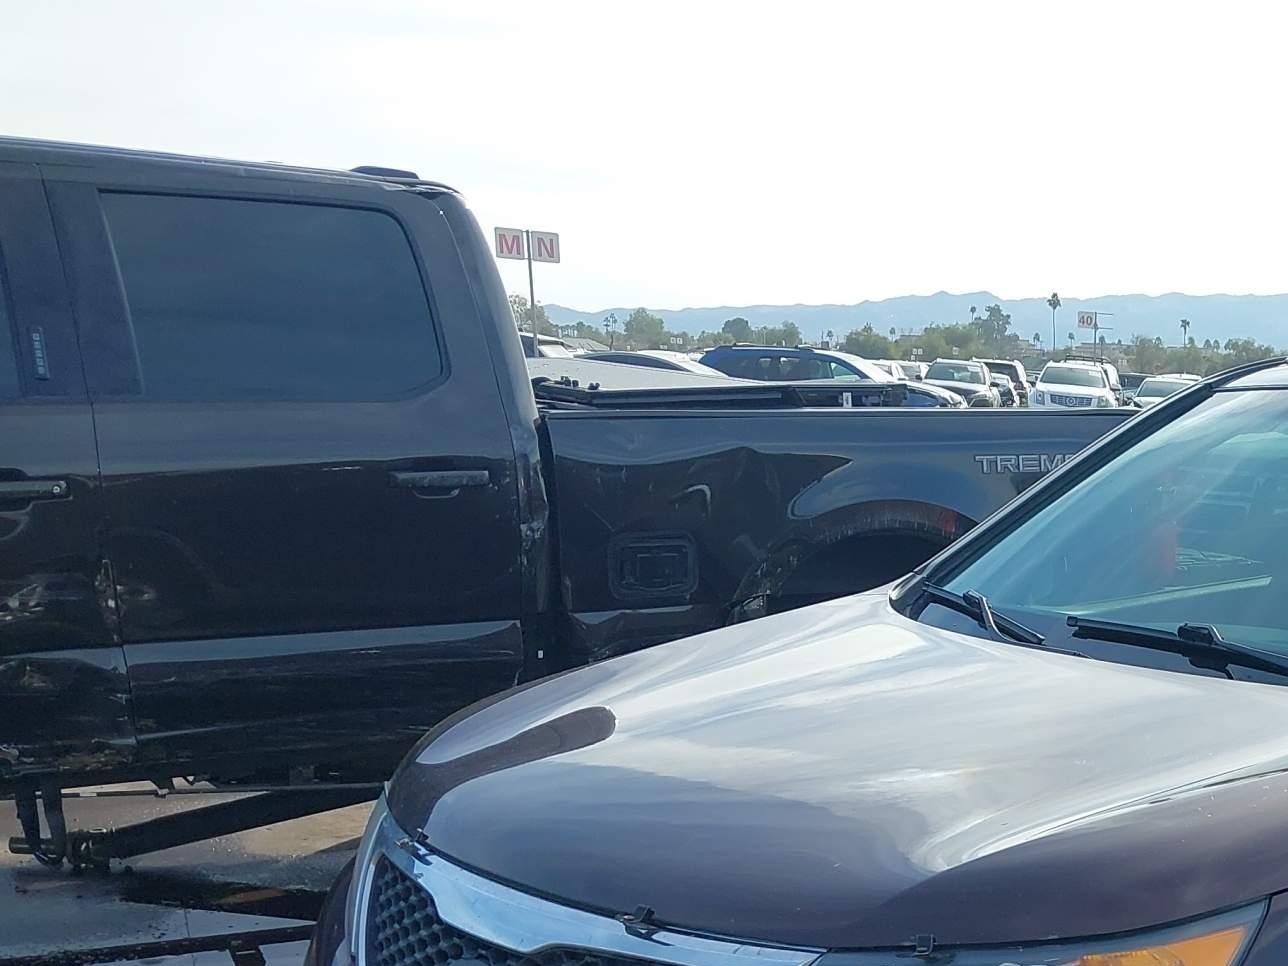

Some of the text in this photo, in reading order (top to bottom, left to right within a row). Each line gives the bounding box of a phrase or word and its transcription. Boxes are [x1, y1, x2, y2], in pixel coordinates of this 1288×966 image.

[498, 233, 521, 256] M
[537, 237, 555, 259] N
[1079, 315, 1093, 327] 40
[975, 453, 1075, 475] TREM
